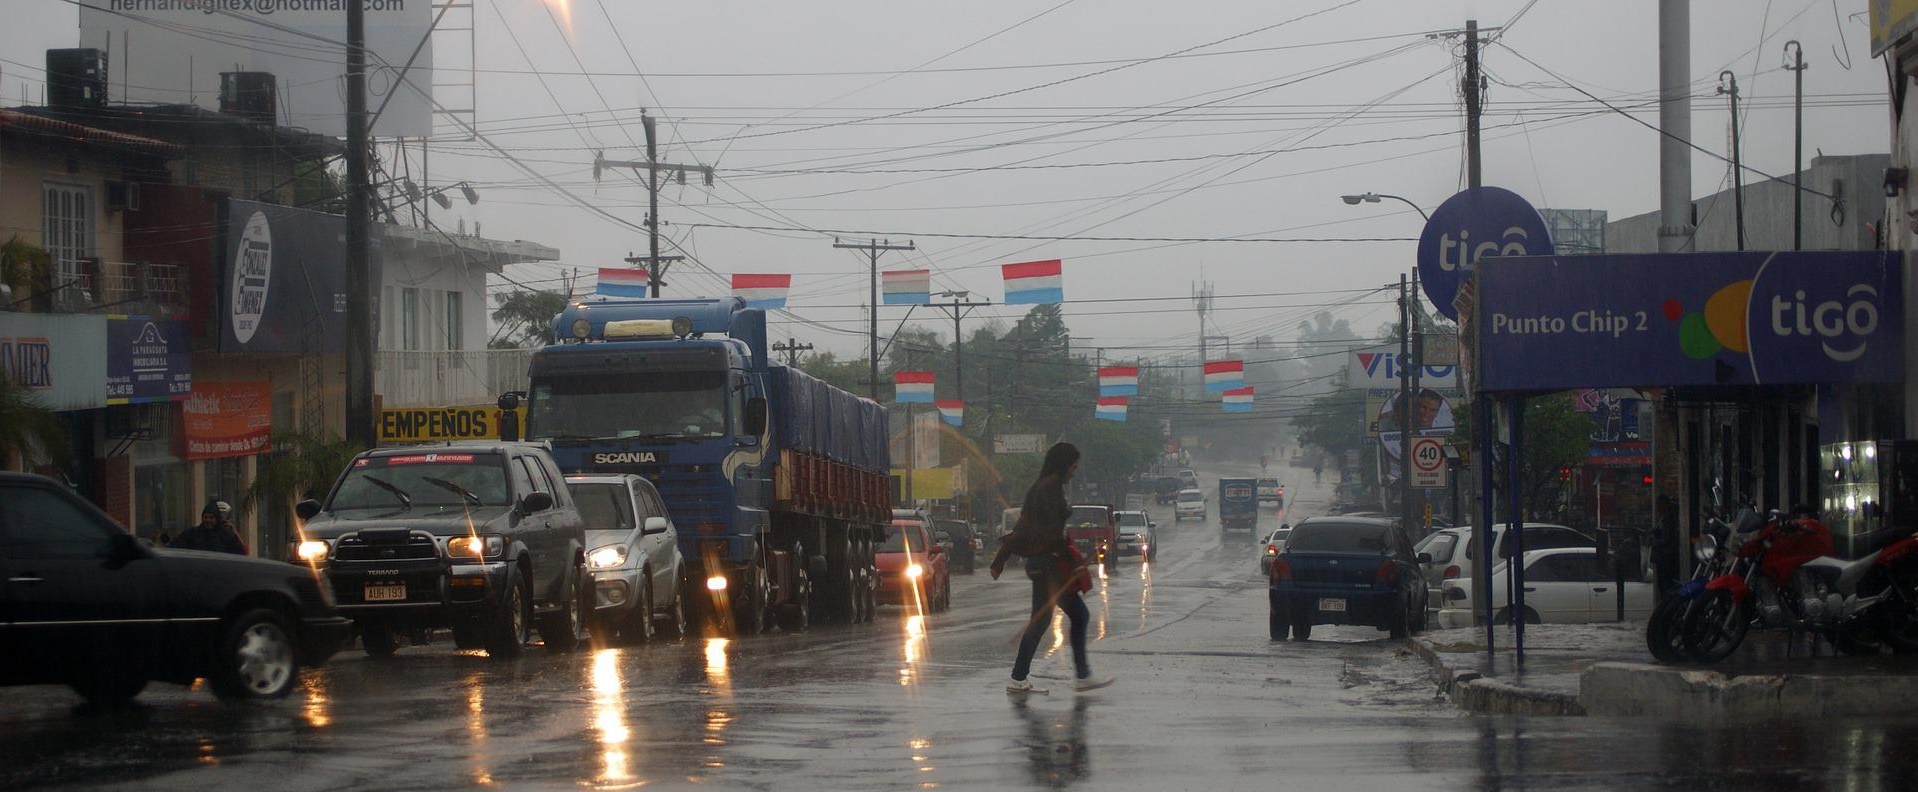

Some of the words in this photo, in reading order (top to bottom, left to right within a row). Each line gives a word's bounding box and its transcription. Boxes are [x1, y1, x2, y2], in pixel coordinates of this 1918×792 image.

[1492, 313, 1565, 334] Punto
[1572, 310, 1629, 338] Chip
[1636, 311, 1648, 332] 2
[184, 392, 219, 414] Athletic
[382, 408, 487, 438] EMPEÑOS
[595, 452, 656, 464] SCANIA
[1419, 447, 1437, 460] 40
